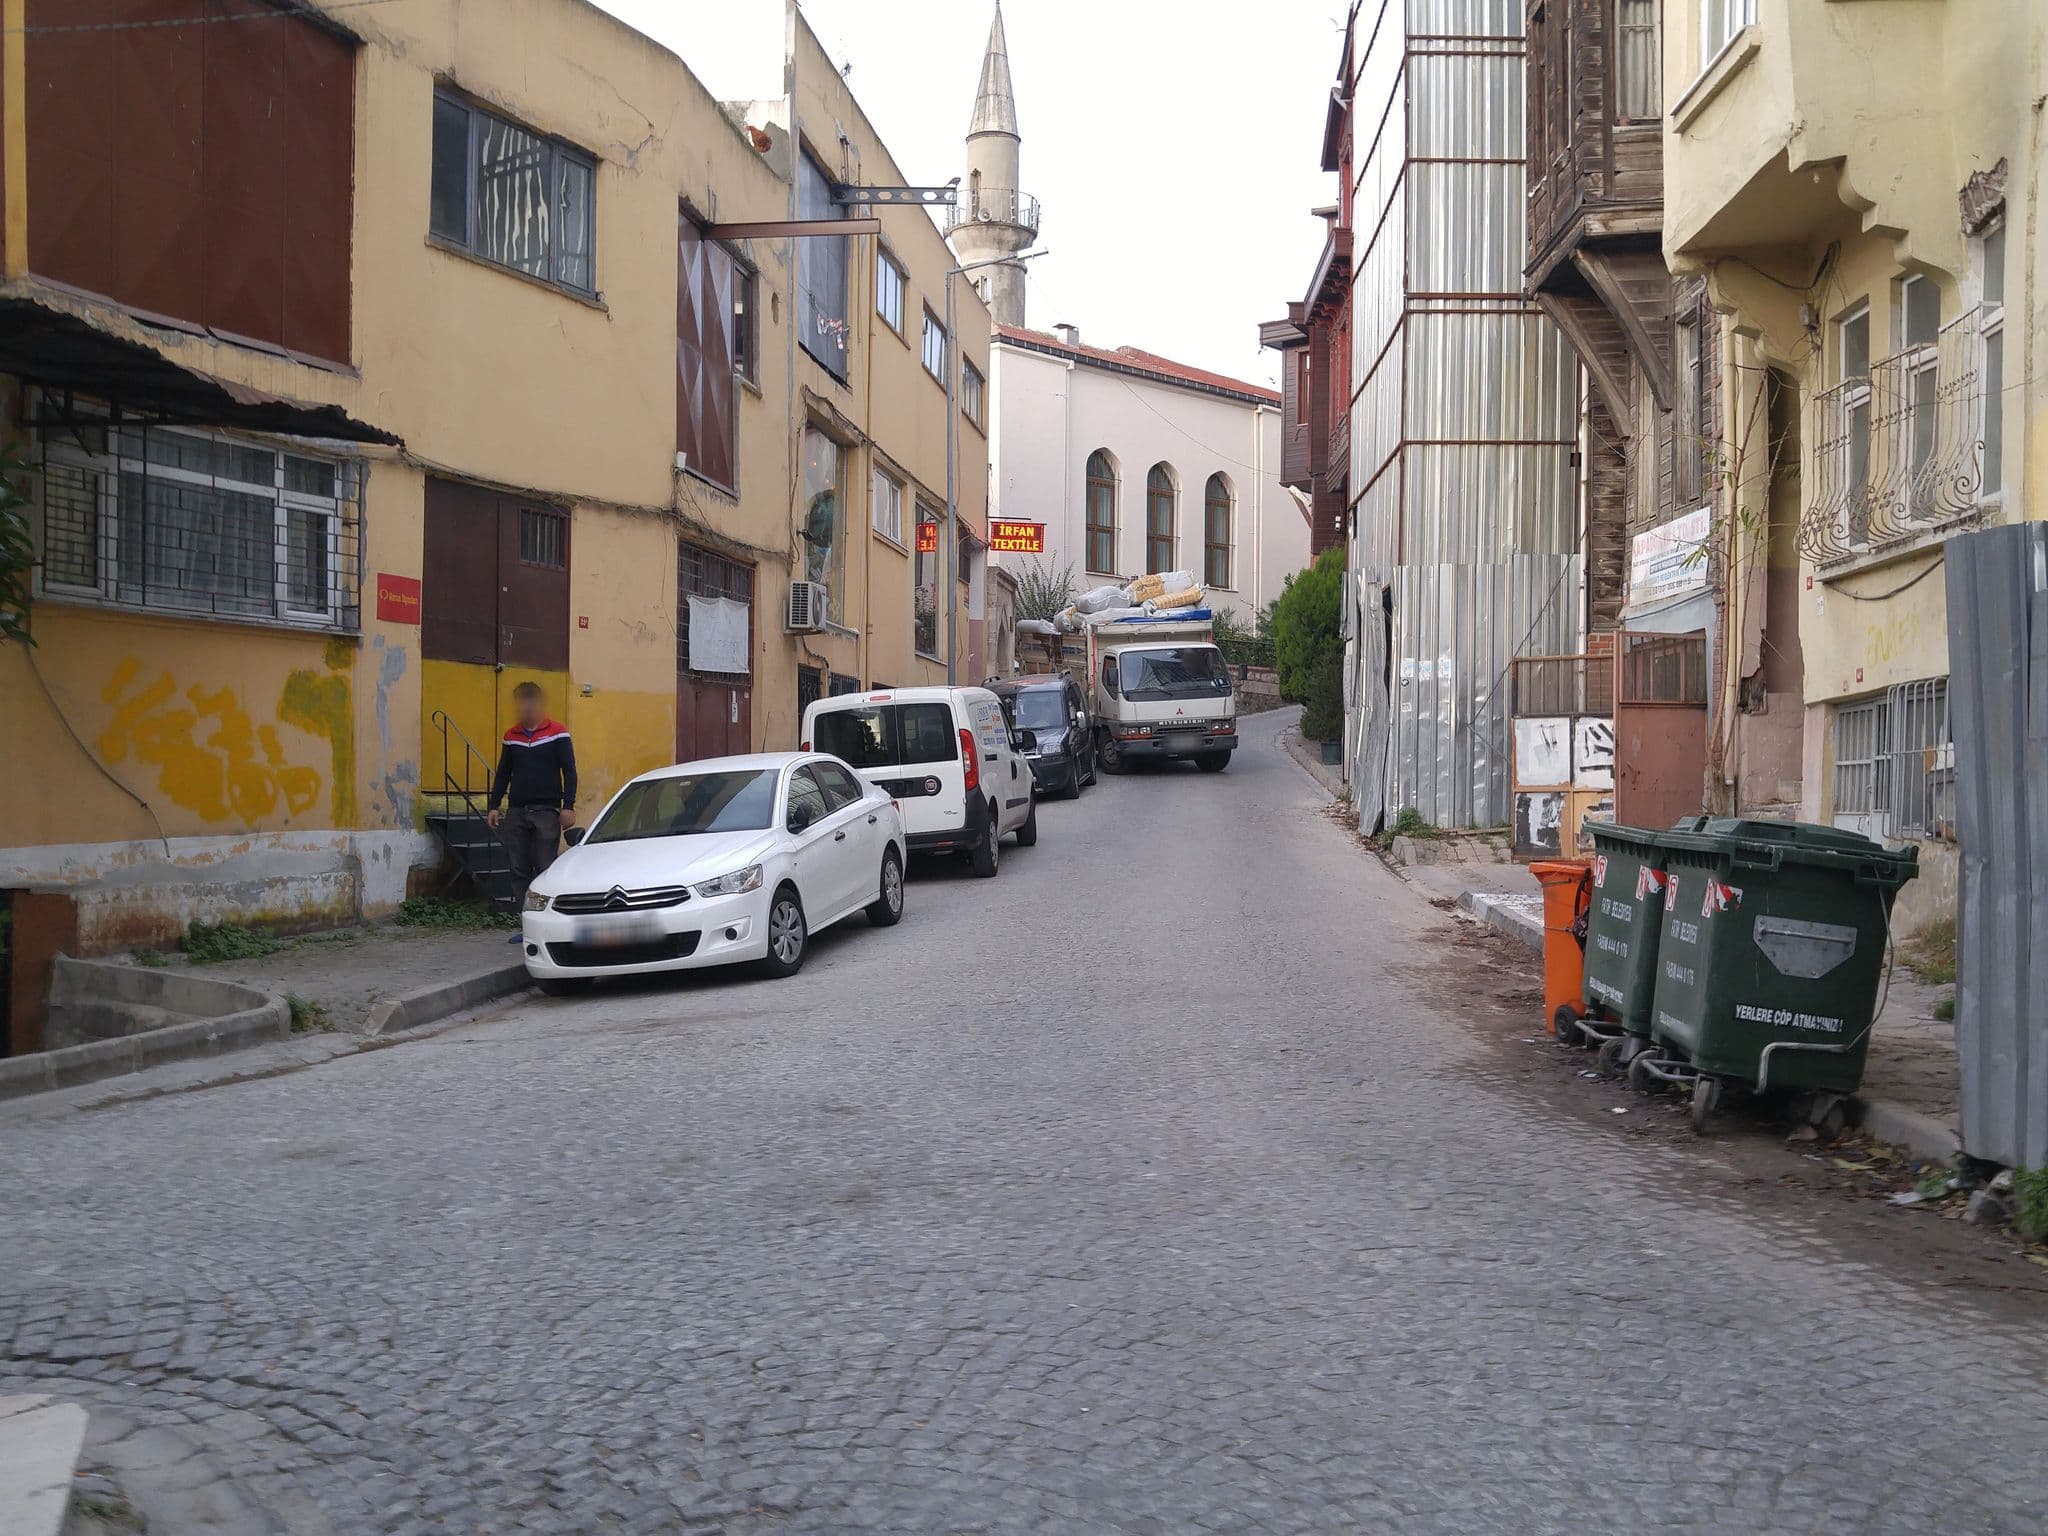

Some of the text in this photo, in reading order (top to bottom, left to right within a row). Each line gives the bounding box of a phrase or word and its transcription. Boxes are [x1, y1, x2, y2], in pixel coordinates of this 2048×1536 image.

[999, 523, 1035, 536] İRFAN
[993, 538, 1040, 551] TEXTİLE
[1736, 1004, 1773, 1024] YERLERE
[1774, 1009, 1793, 1026] ÇÖP
